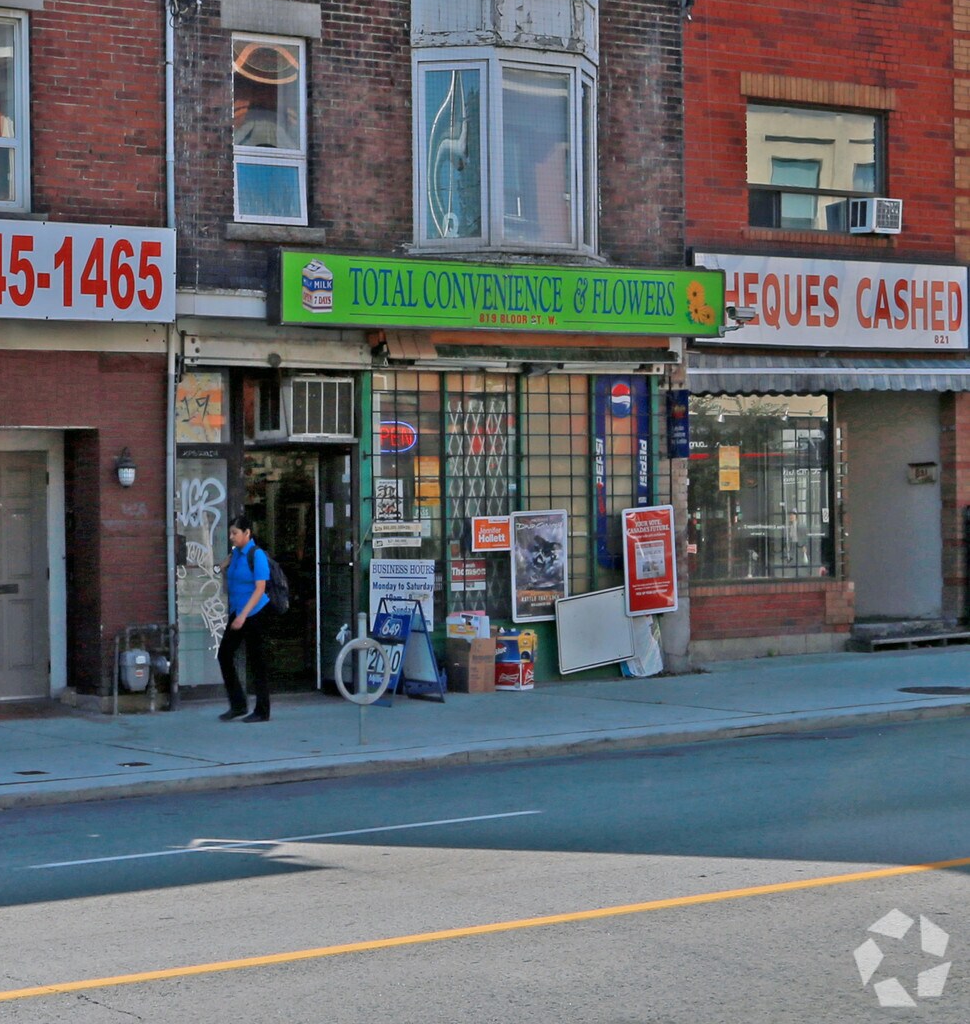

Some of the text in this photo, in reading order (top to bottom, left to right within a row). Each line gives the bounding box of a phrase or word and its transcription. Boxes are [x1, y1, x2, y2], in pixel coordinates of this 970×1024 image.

[314, 280, 332, 289] MILK
[349, 268, 675, 317] TOTAL CONVENIENCE & FLOWERS
[318, 296, 332, 305] DAYS
[856, 277, 963, 331] CASHED
[479, 313, 497, 323] 819
[500, 313, 528, 324] BLOOR
[548, 316, 558, 325] W.
[934, 335, 949, 345] 821
[595, 438, 604, 486] PEPSI
[639, 439, 647, 487] PEPSI
[478, 534, 506, 543] Hollett
[372, 564, 435, 575] BUSINESS HOURS
[373, 582, 434, 592] Monday to Saturday
[382, 619, 401, 635] 649
